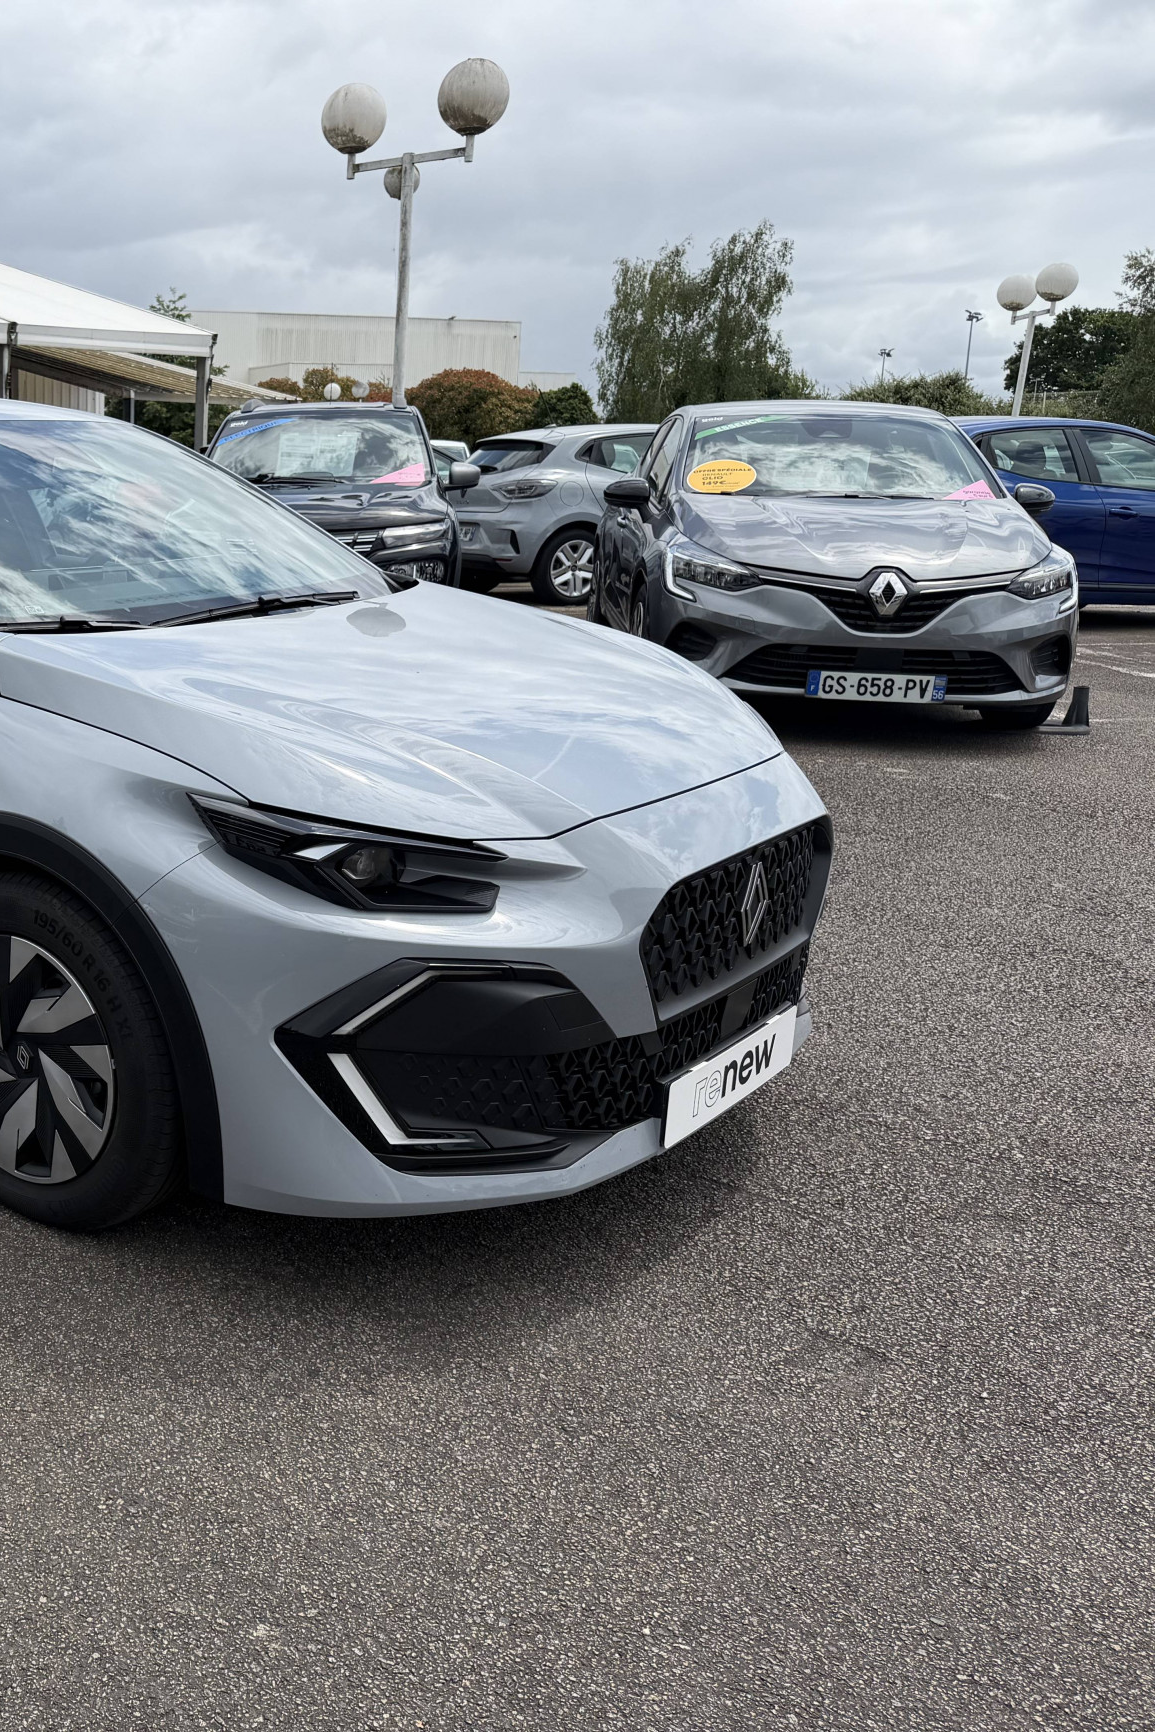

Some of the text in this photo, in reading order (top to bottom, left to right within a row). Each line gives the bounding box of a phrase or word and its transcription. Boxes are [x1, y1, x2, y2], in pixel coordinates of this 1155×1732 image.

[714, 417, 762, 432] ESSENCE
[821, 675, 931, 700] GS-658-PV
[932, 690, 945, 700] 56
[33, 909, 84, 957] 195/60
[692, 1033, 777, 1118] renew
